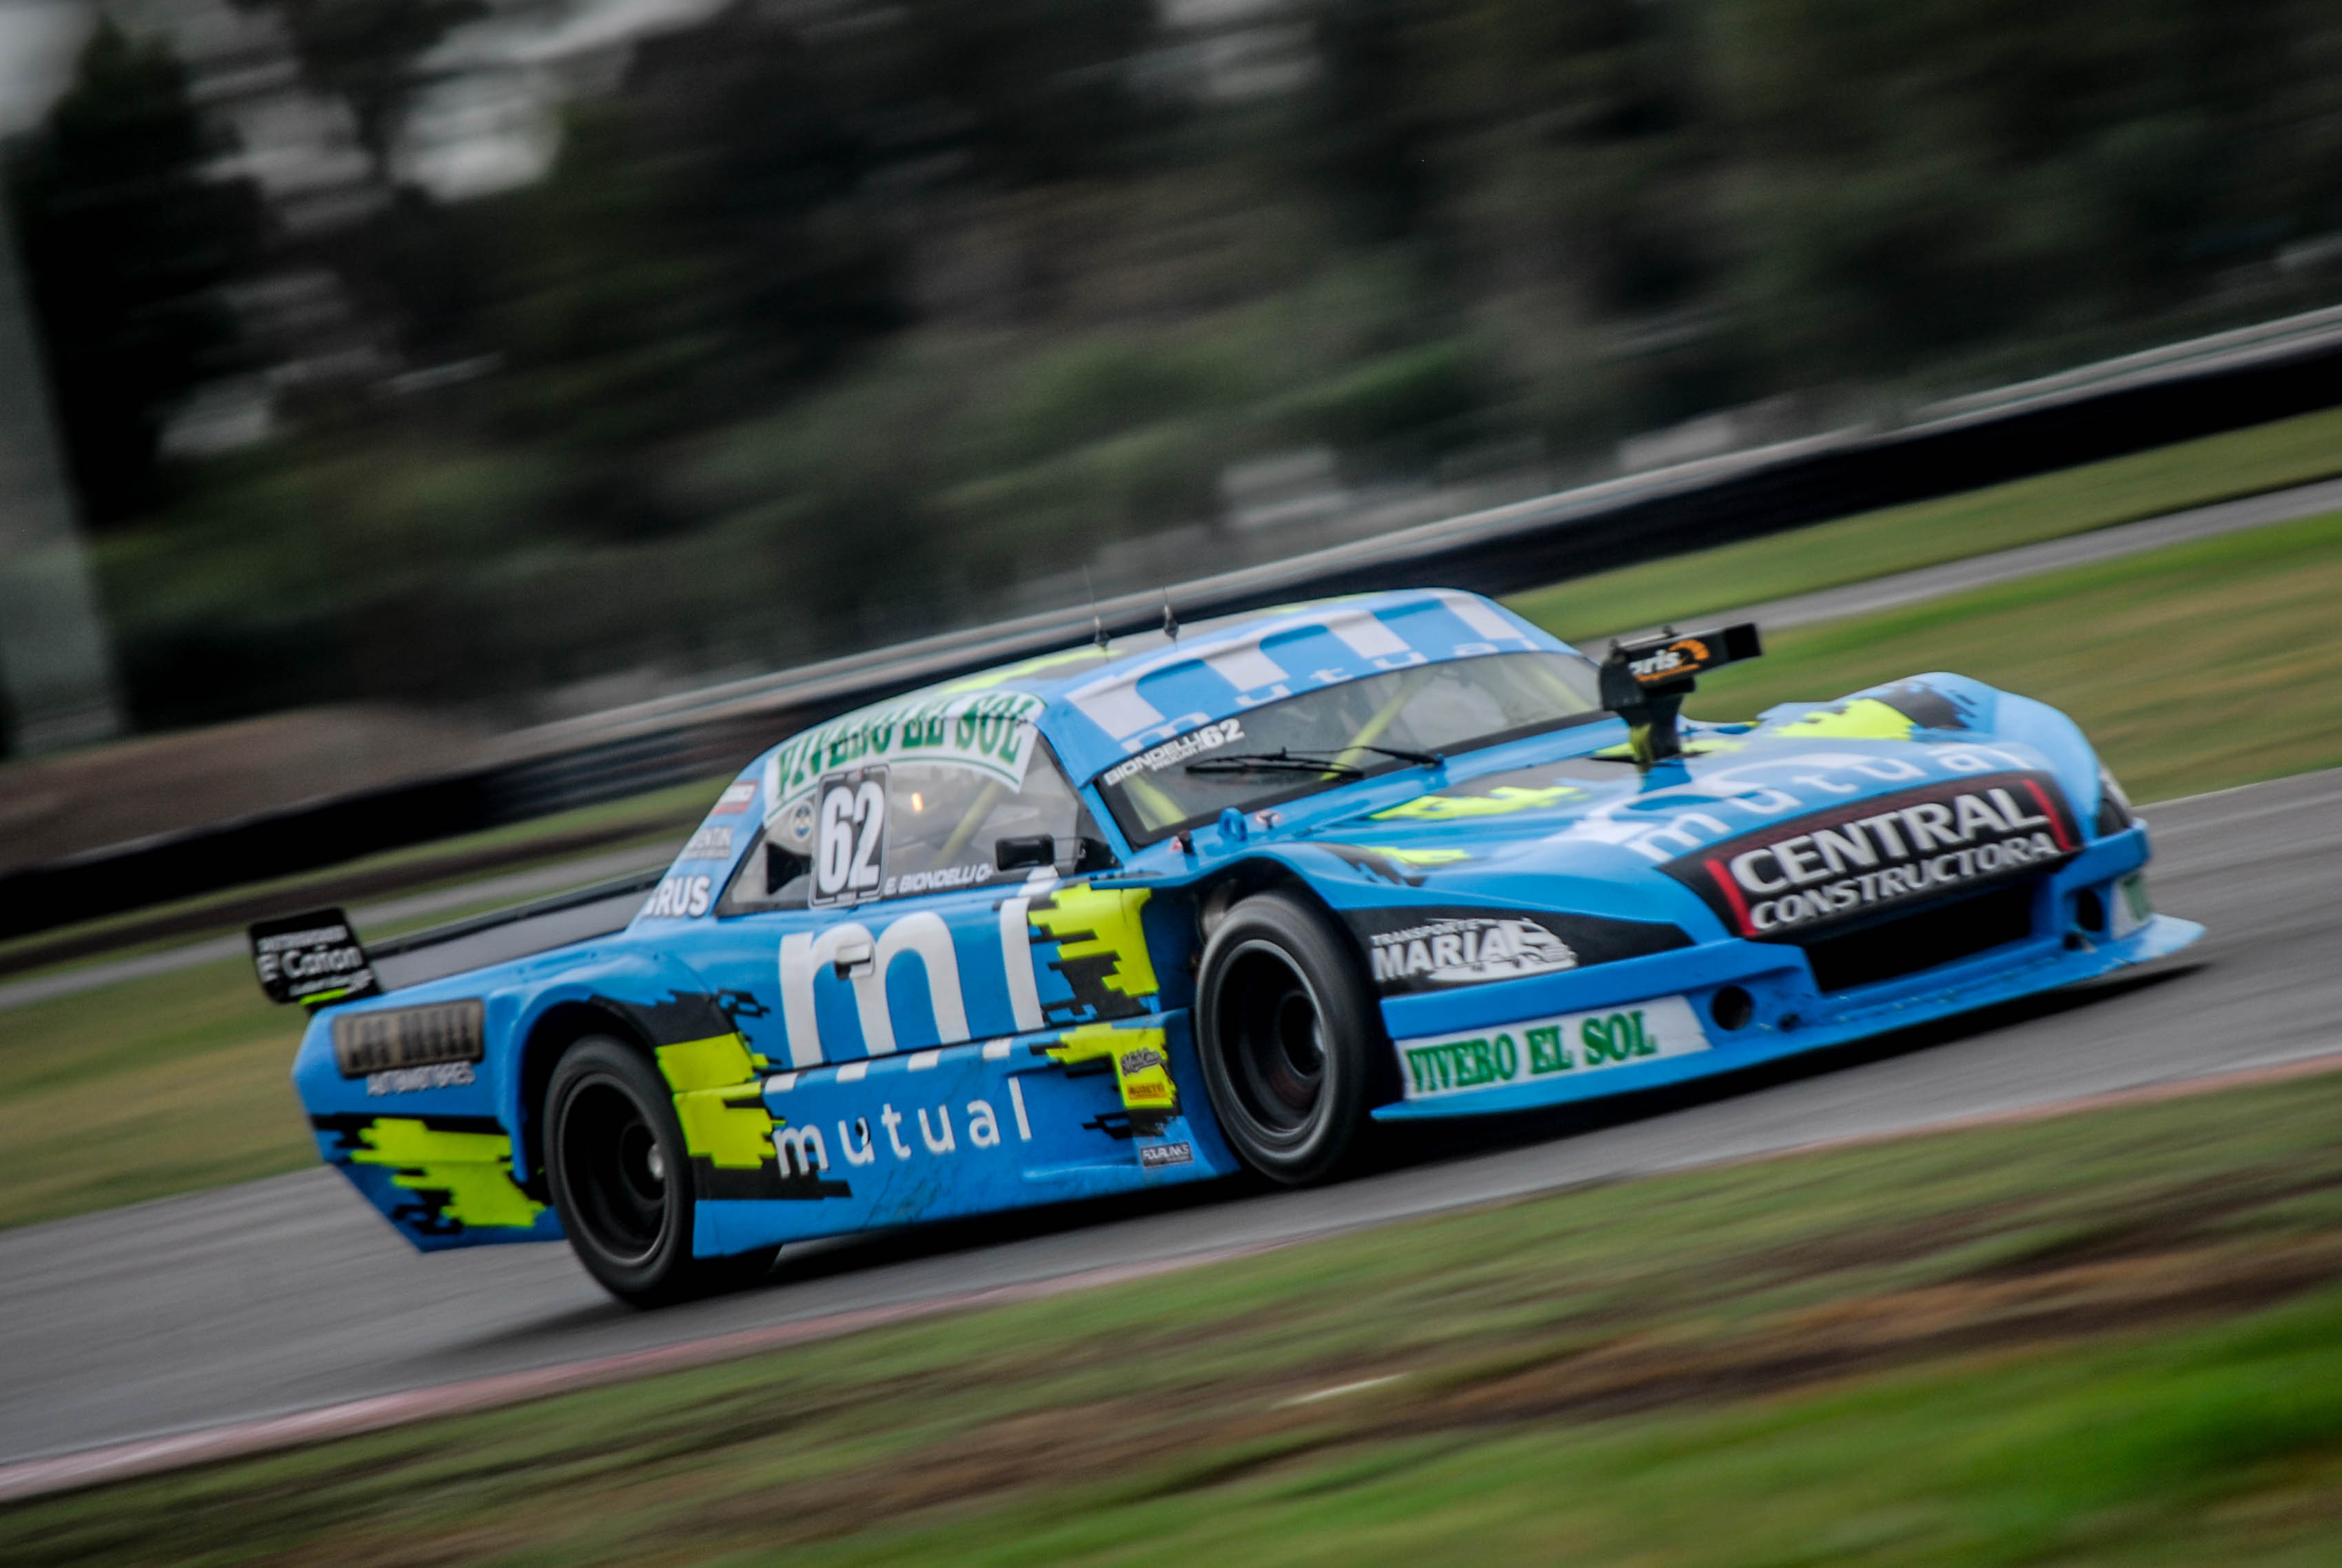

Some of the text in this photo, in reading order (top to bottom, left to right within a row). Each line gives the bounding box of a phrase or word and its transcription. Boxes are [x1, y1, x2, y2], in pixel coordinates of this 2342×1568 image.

[901, 698, 955, 749] EL
[955, 692, 1036, 765] SOL
[1103, 731, 1201, 786] BIONDELLI
[1199, 717, 1245, 749] 62
[819, 780, 884, 894] 62
[1729, 787, 2052, 894] CENTRAL
[898, 865, 976, 894] BIONDELLI
[1751, 831, 2061, 930] CONSTRUCTORA
[1371, 922, 1521, 982] MARIA
[1406, 1010, 1658, 1092] VIVERO EL SOL
[772, 1075, 1032, 1179] mutual
